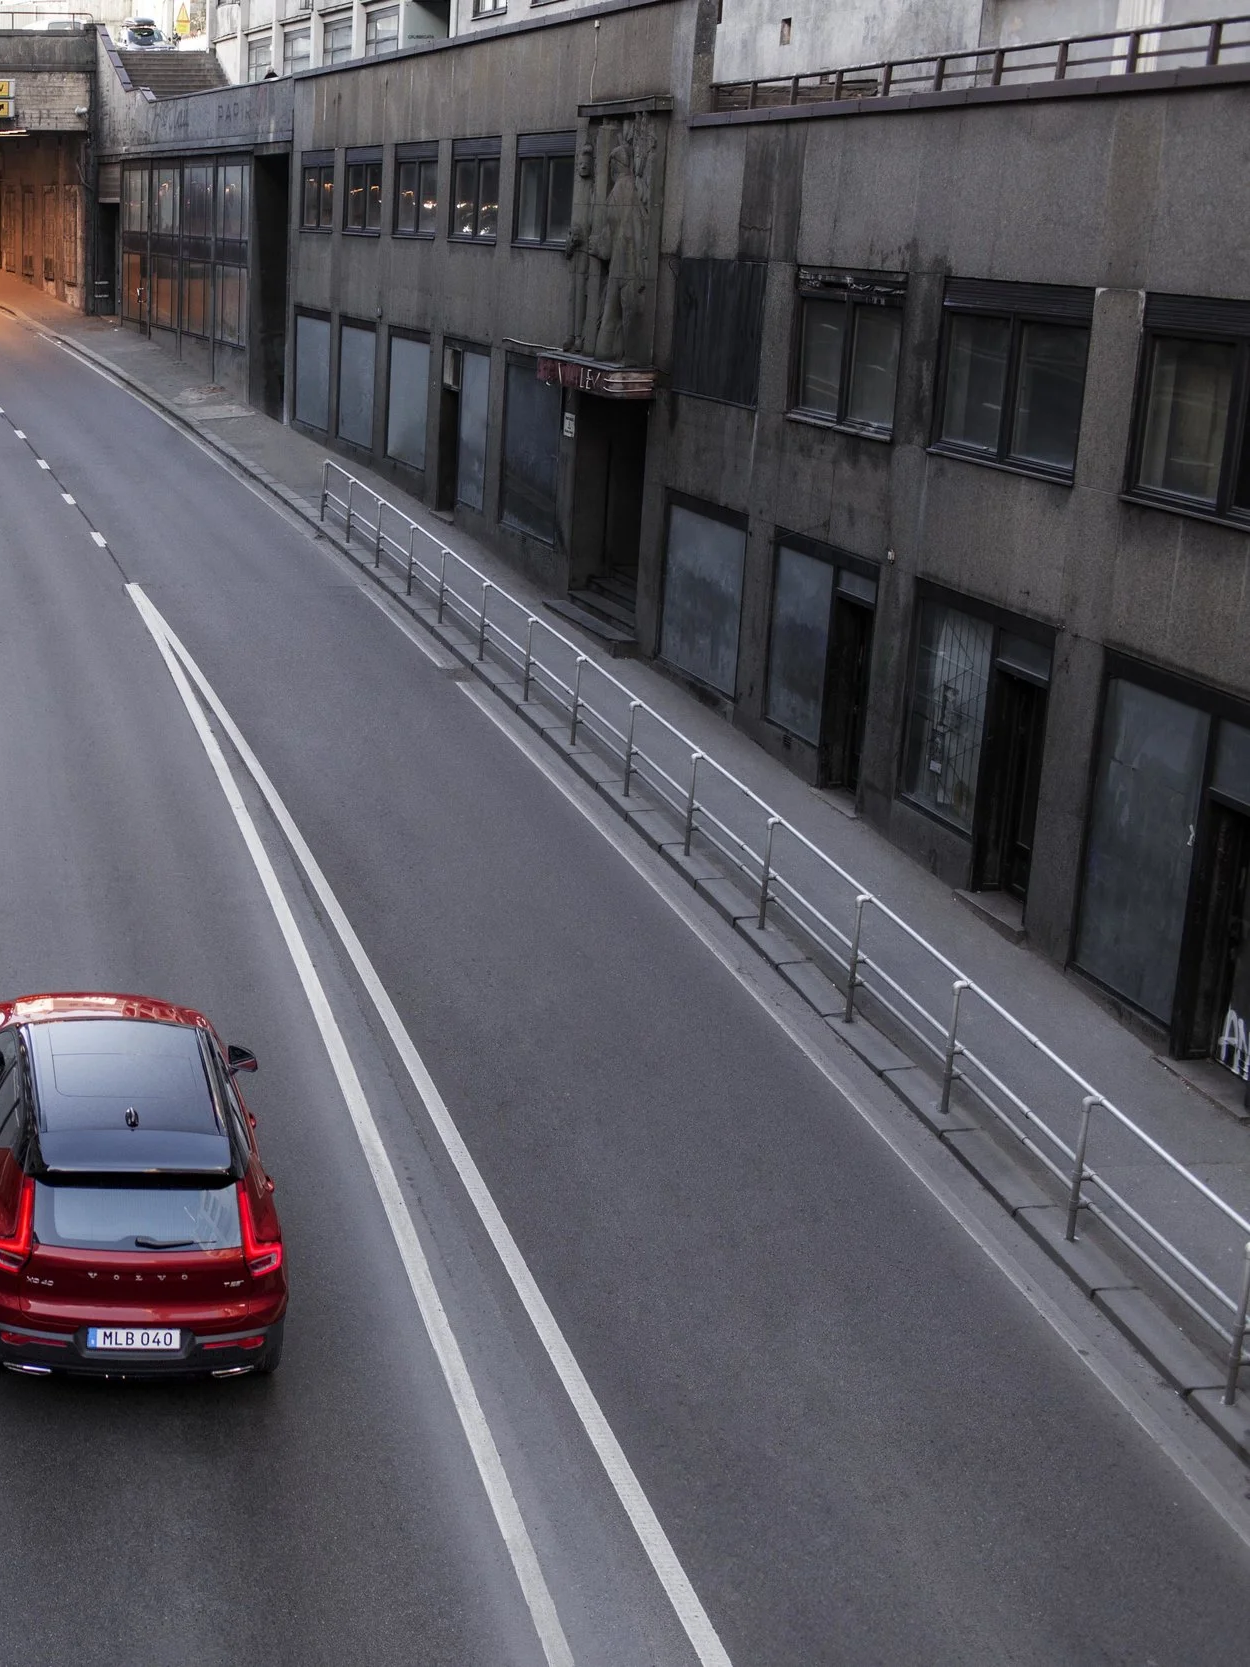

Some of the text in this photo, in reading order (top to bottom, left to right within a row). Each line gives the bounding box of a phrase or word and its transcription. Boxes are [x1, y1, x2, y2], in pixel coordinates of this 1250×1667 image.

[88, 1272, 188, 1282] VOLVO
[102, 1331, 173, 1346] MLB 040
